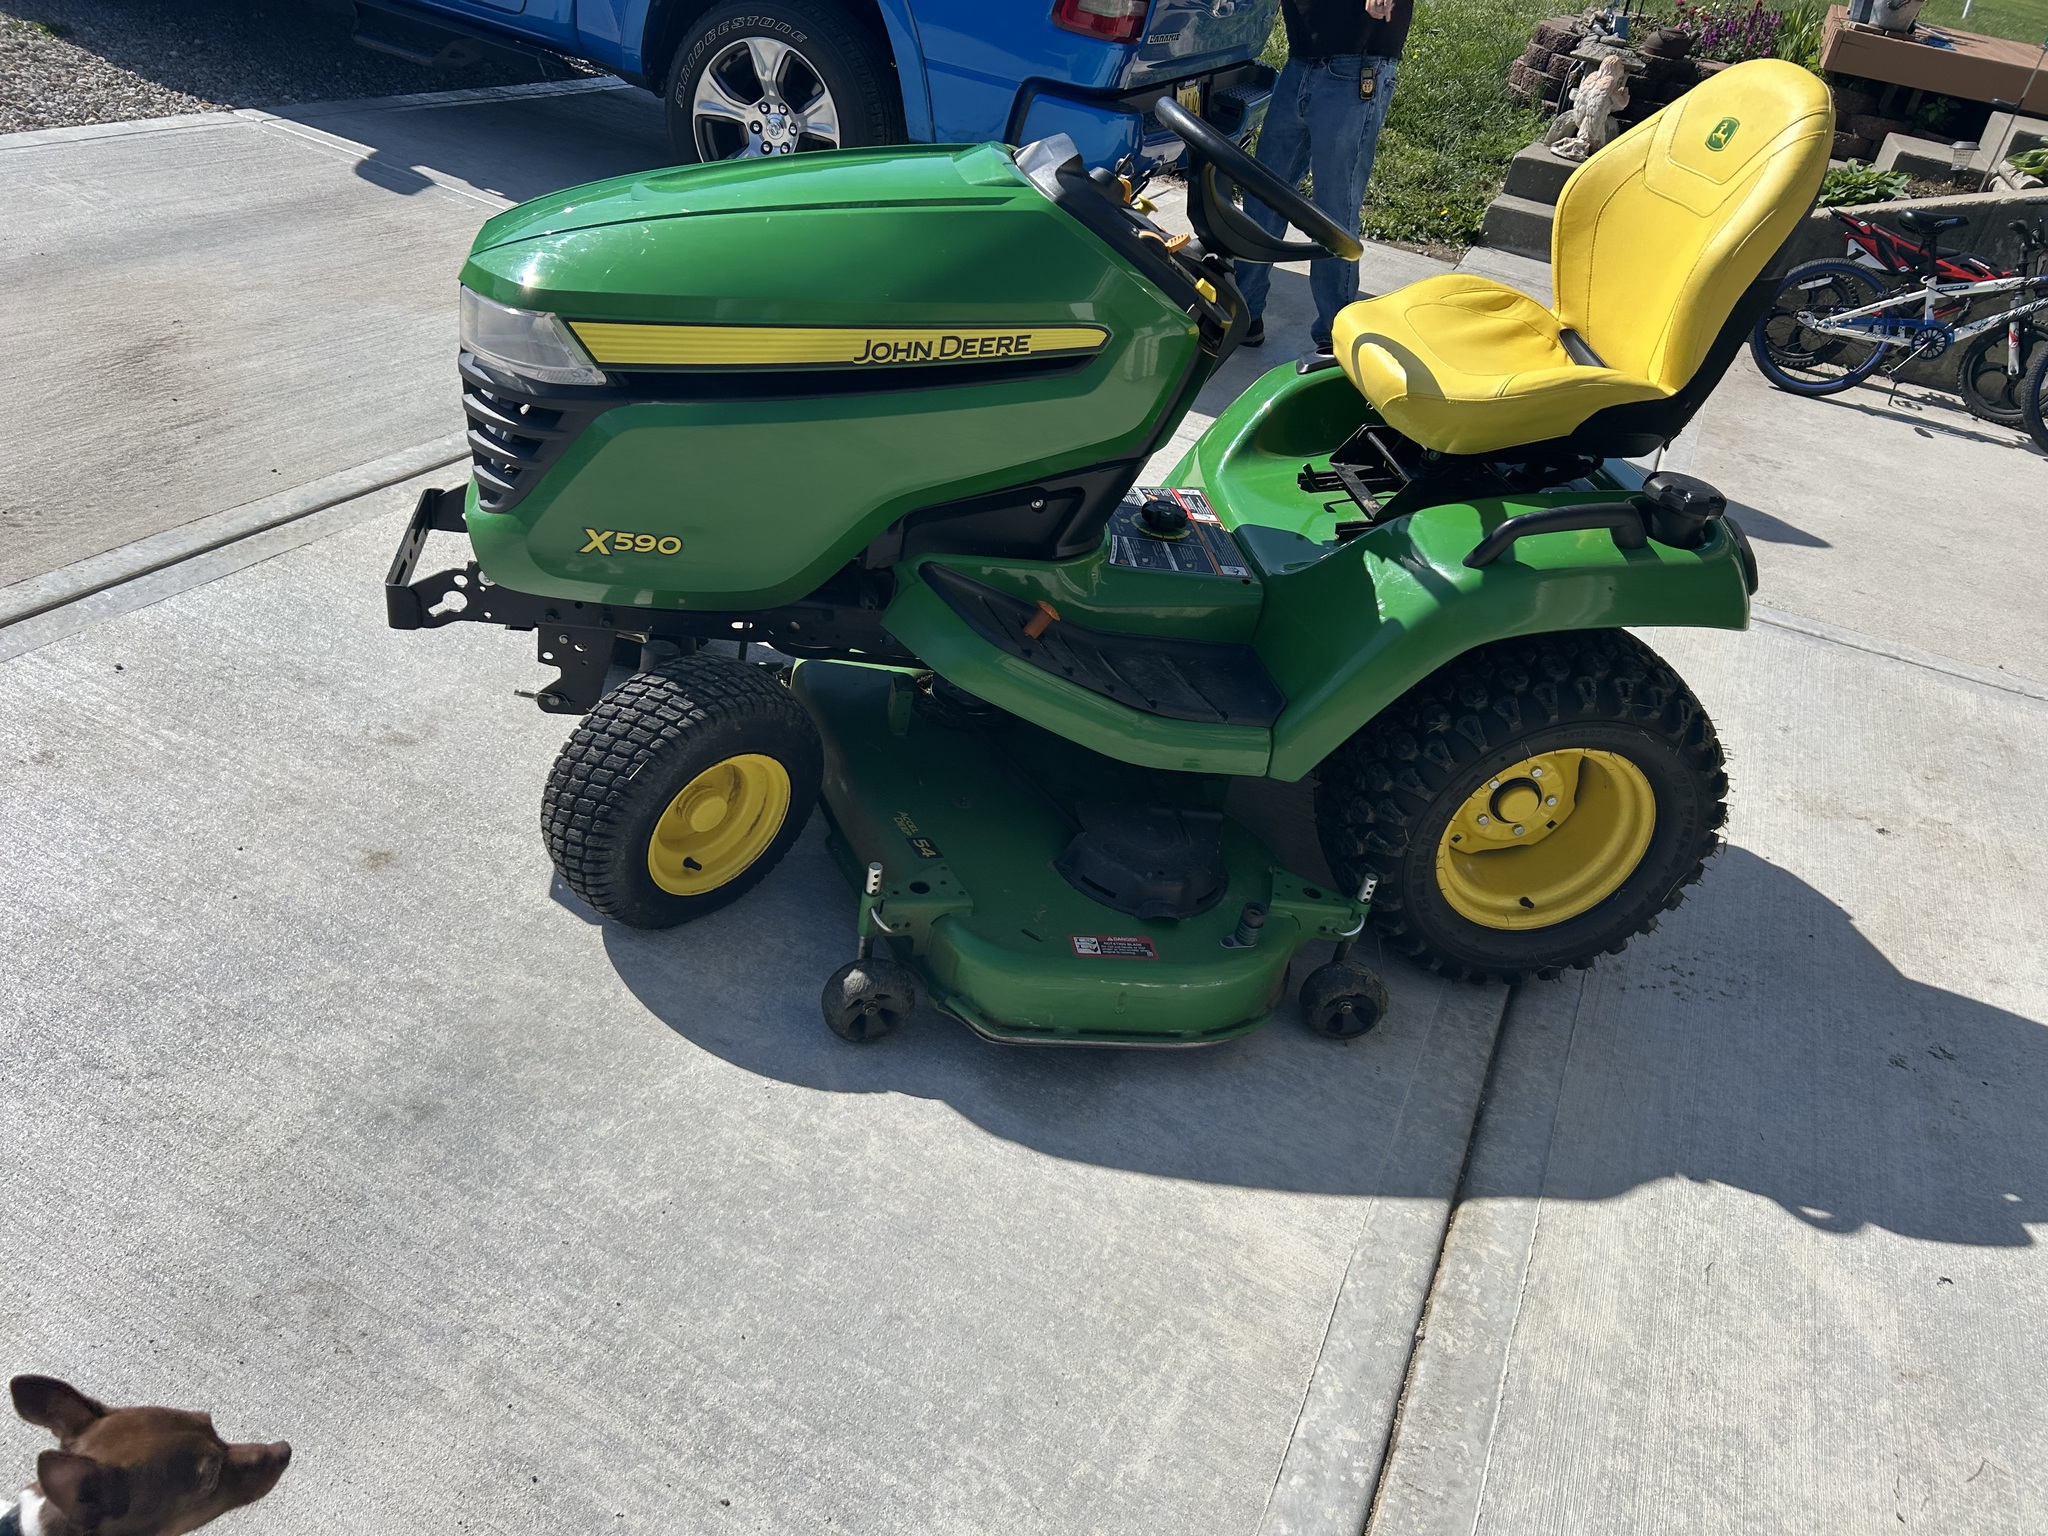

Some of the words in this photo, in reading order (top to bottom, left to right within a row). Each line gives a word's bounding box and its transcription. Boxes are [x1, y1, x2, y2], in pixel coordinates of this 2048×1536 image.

[675, 15, 808, 108] BRIDGESTONE
[853, 339, 934, 364] JOHN
[938, 334, 1032, 360] DEERE
[579, 527, 682, 556] X590
[912, 839, 937, 857] 54
